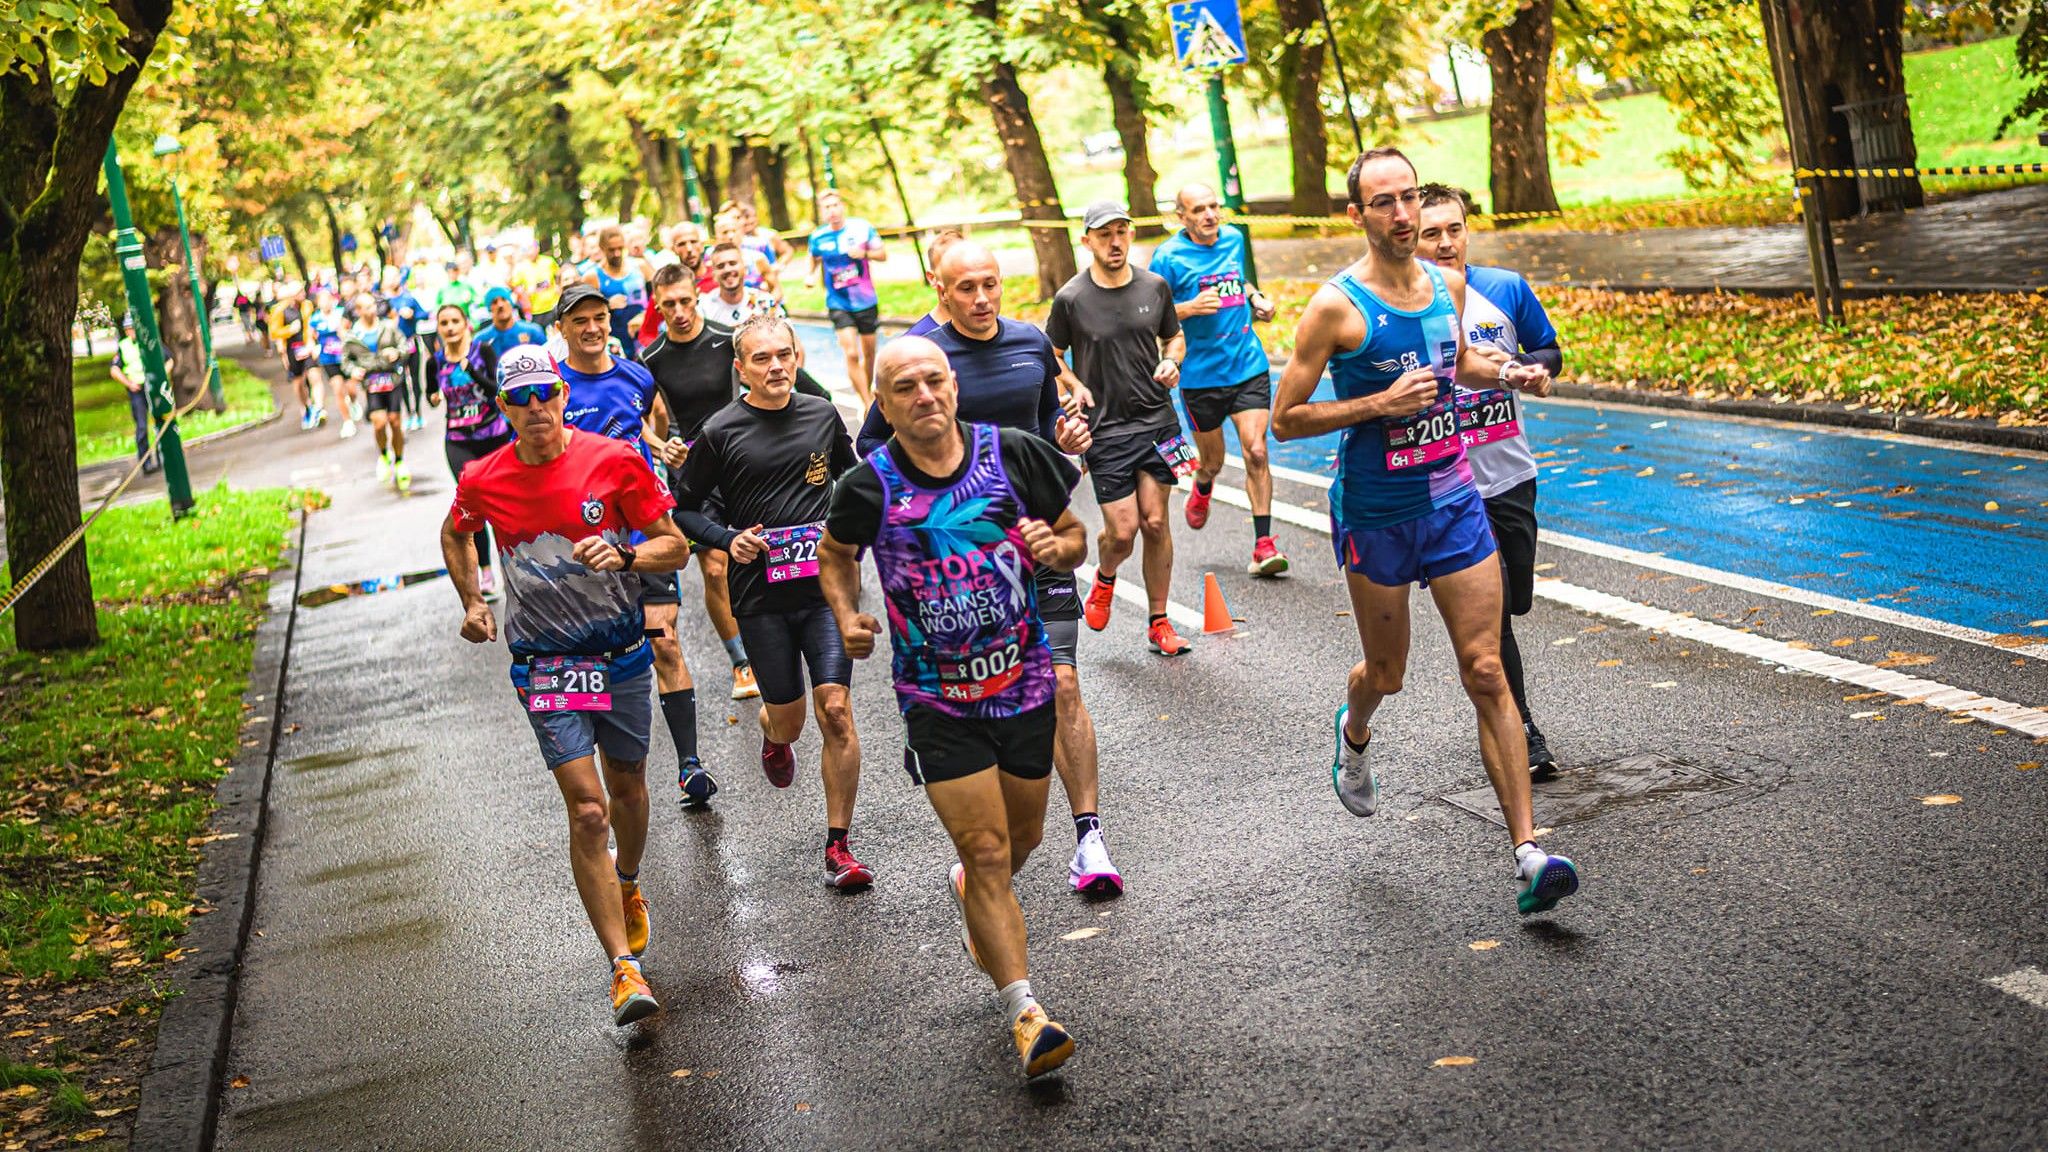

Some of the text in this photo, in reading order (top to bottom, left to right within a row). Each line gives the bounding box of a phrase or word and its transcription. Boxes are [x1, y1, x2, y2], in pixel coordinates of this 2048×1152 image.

[1218, 279, 1242, 298] 216
[1400, 351, 1418, 366] CR
[1482, 400, 1512, 427] 221
[1416, 411, 1456, 446] 203
[1391, 451, 1409, 467] 6H
[792, 540, 821, 562] 22
[771, 567, 786, 580] 6H
[908, 550, 987, 587] STOP
[912, 573, 997, 600] VIOLENCE
[919, 587, 997, 616] AGAINST
[921, 603, 1006, 634] WOMEN
[970, 643, 1021, 681] 002
[563, 670, 605, 693] 218
[945, 685, 968, 700] 24H
[533, 696, 551, 709] 6H
